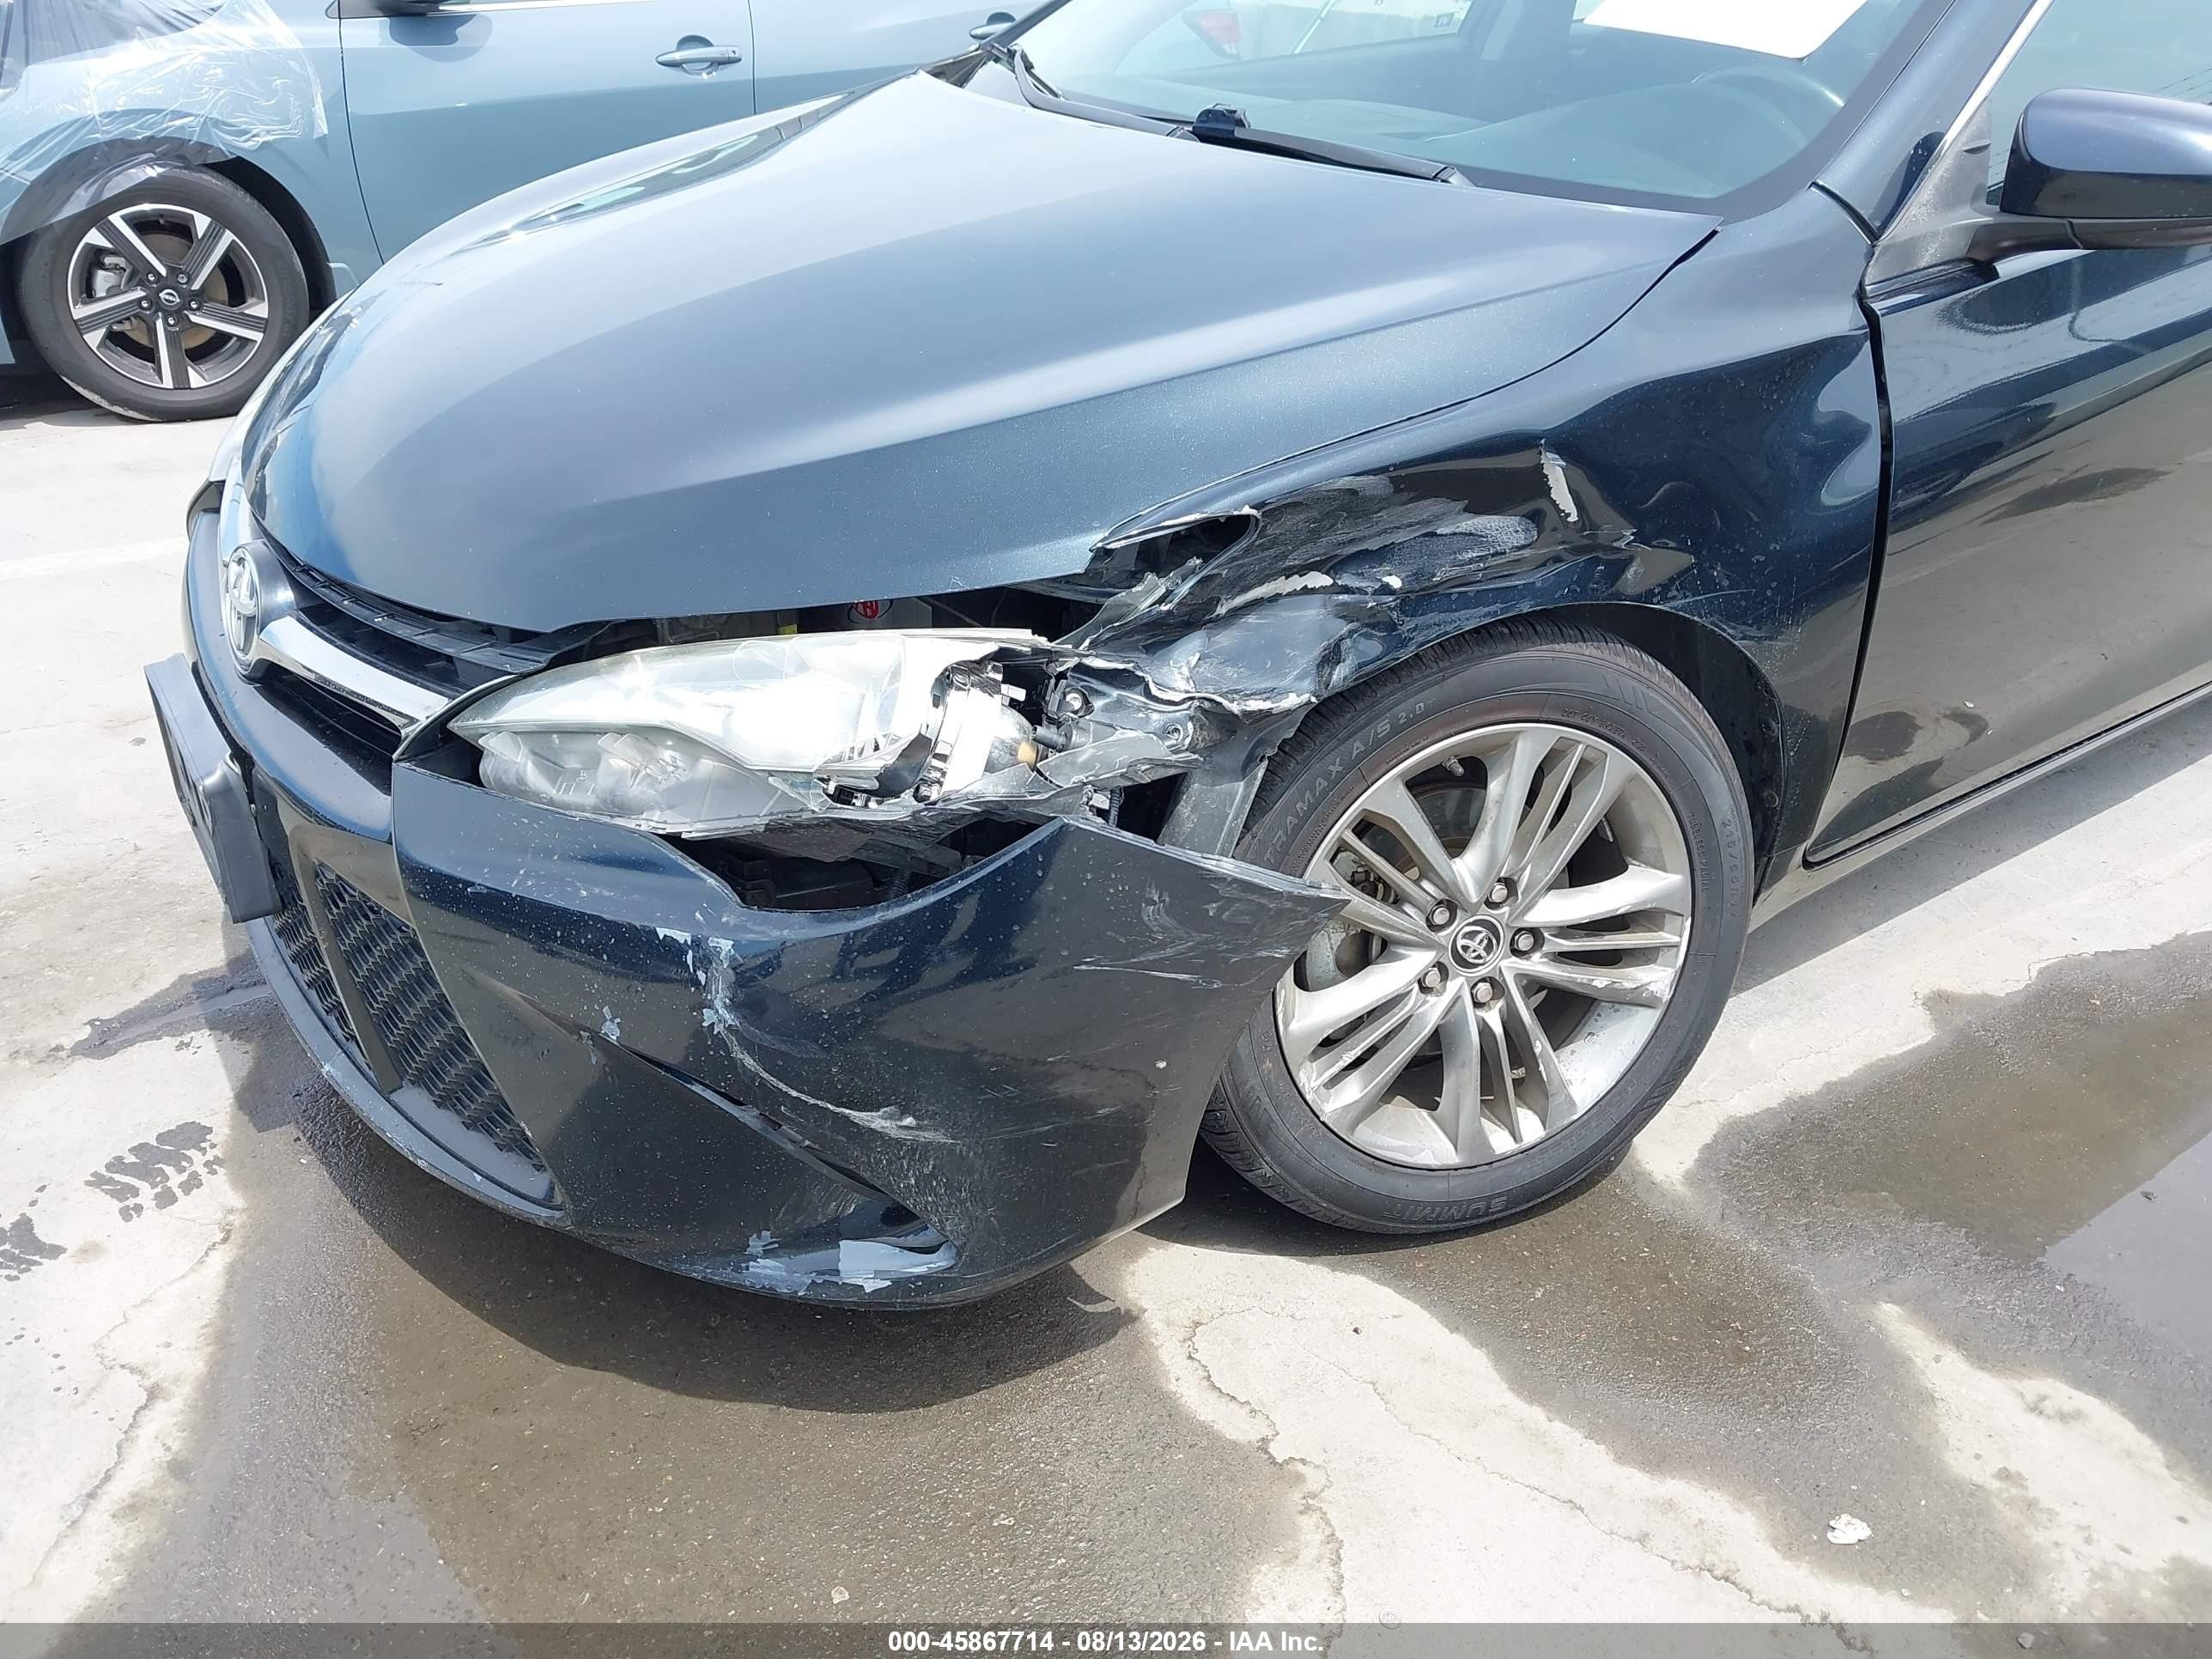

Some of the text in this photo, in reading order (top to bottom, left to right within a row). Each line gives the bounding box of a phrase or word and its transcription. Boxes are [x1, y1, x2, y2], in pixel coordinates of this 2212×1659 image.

[1352, 720, 1391, 760] A/S
[1398, 702, 1425, 724] 2.0
[1382, 1196, 1507, 1221] SUMMIT
